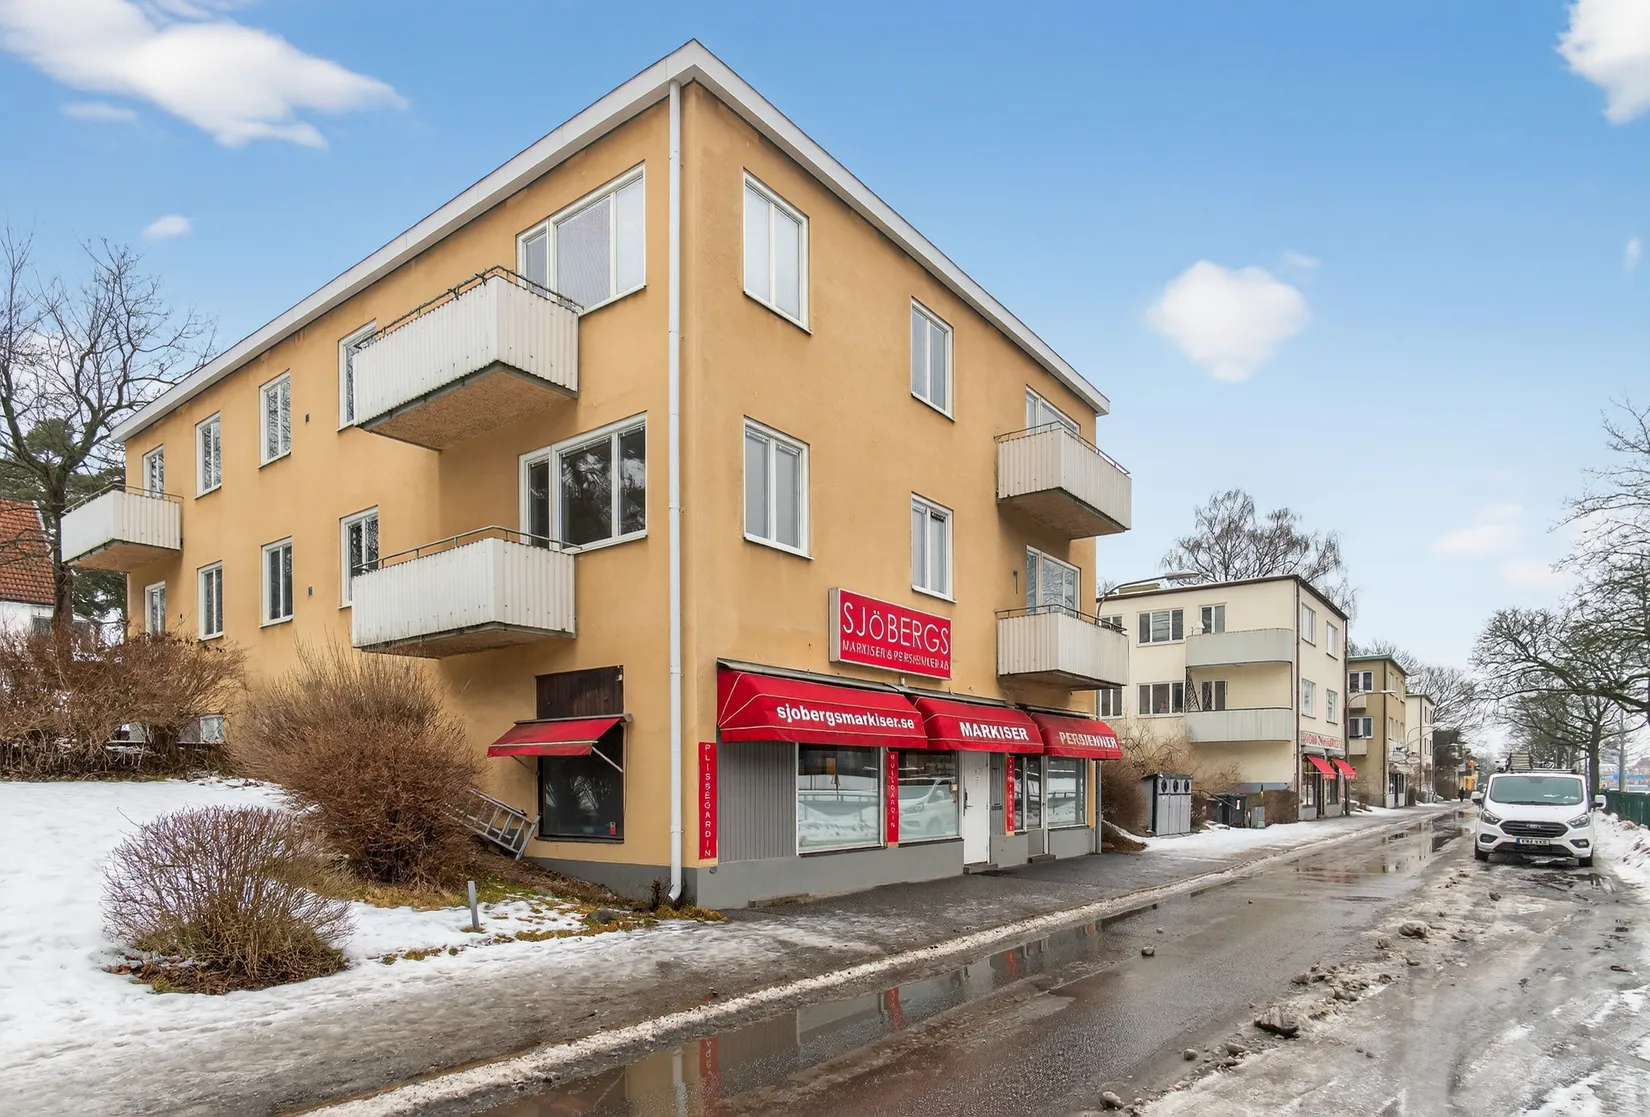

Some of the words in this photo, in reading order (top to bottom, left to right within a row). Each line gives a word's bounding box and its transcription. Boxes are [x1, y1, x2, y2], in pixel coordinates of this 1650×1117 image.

[843, 602, 949, 655] SJÖBERGS
[776, 703, 915, 729] sjobergsmarkiser.se
[959, 721, 1029, 741] MARKISER
[1058, 731, 1118, 749] PERSIENNER
